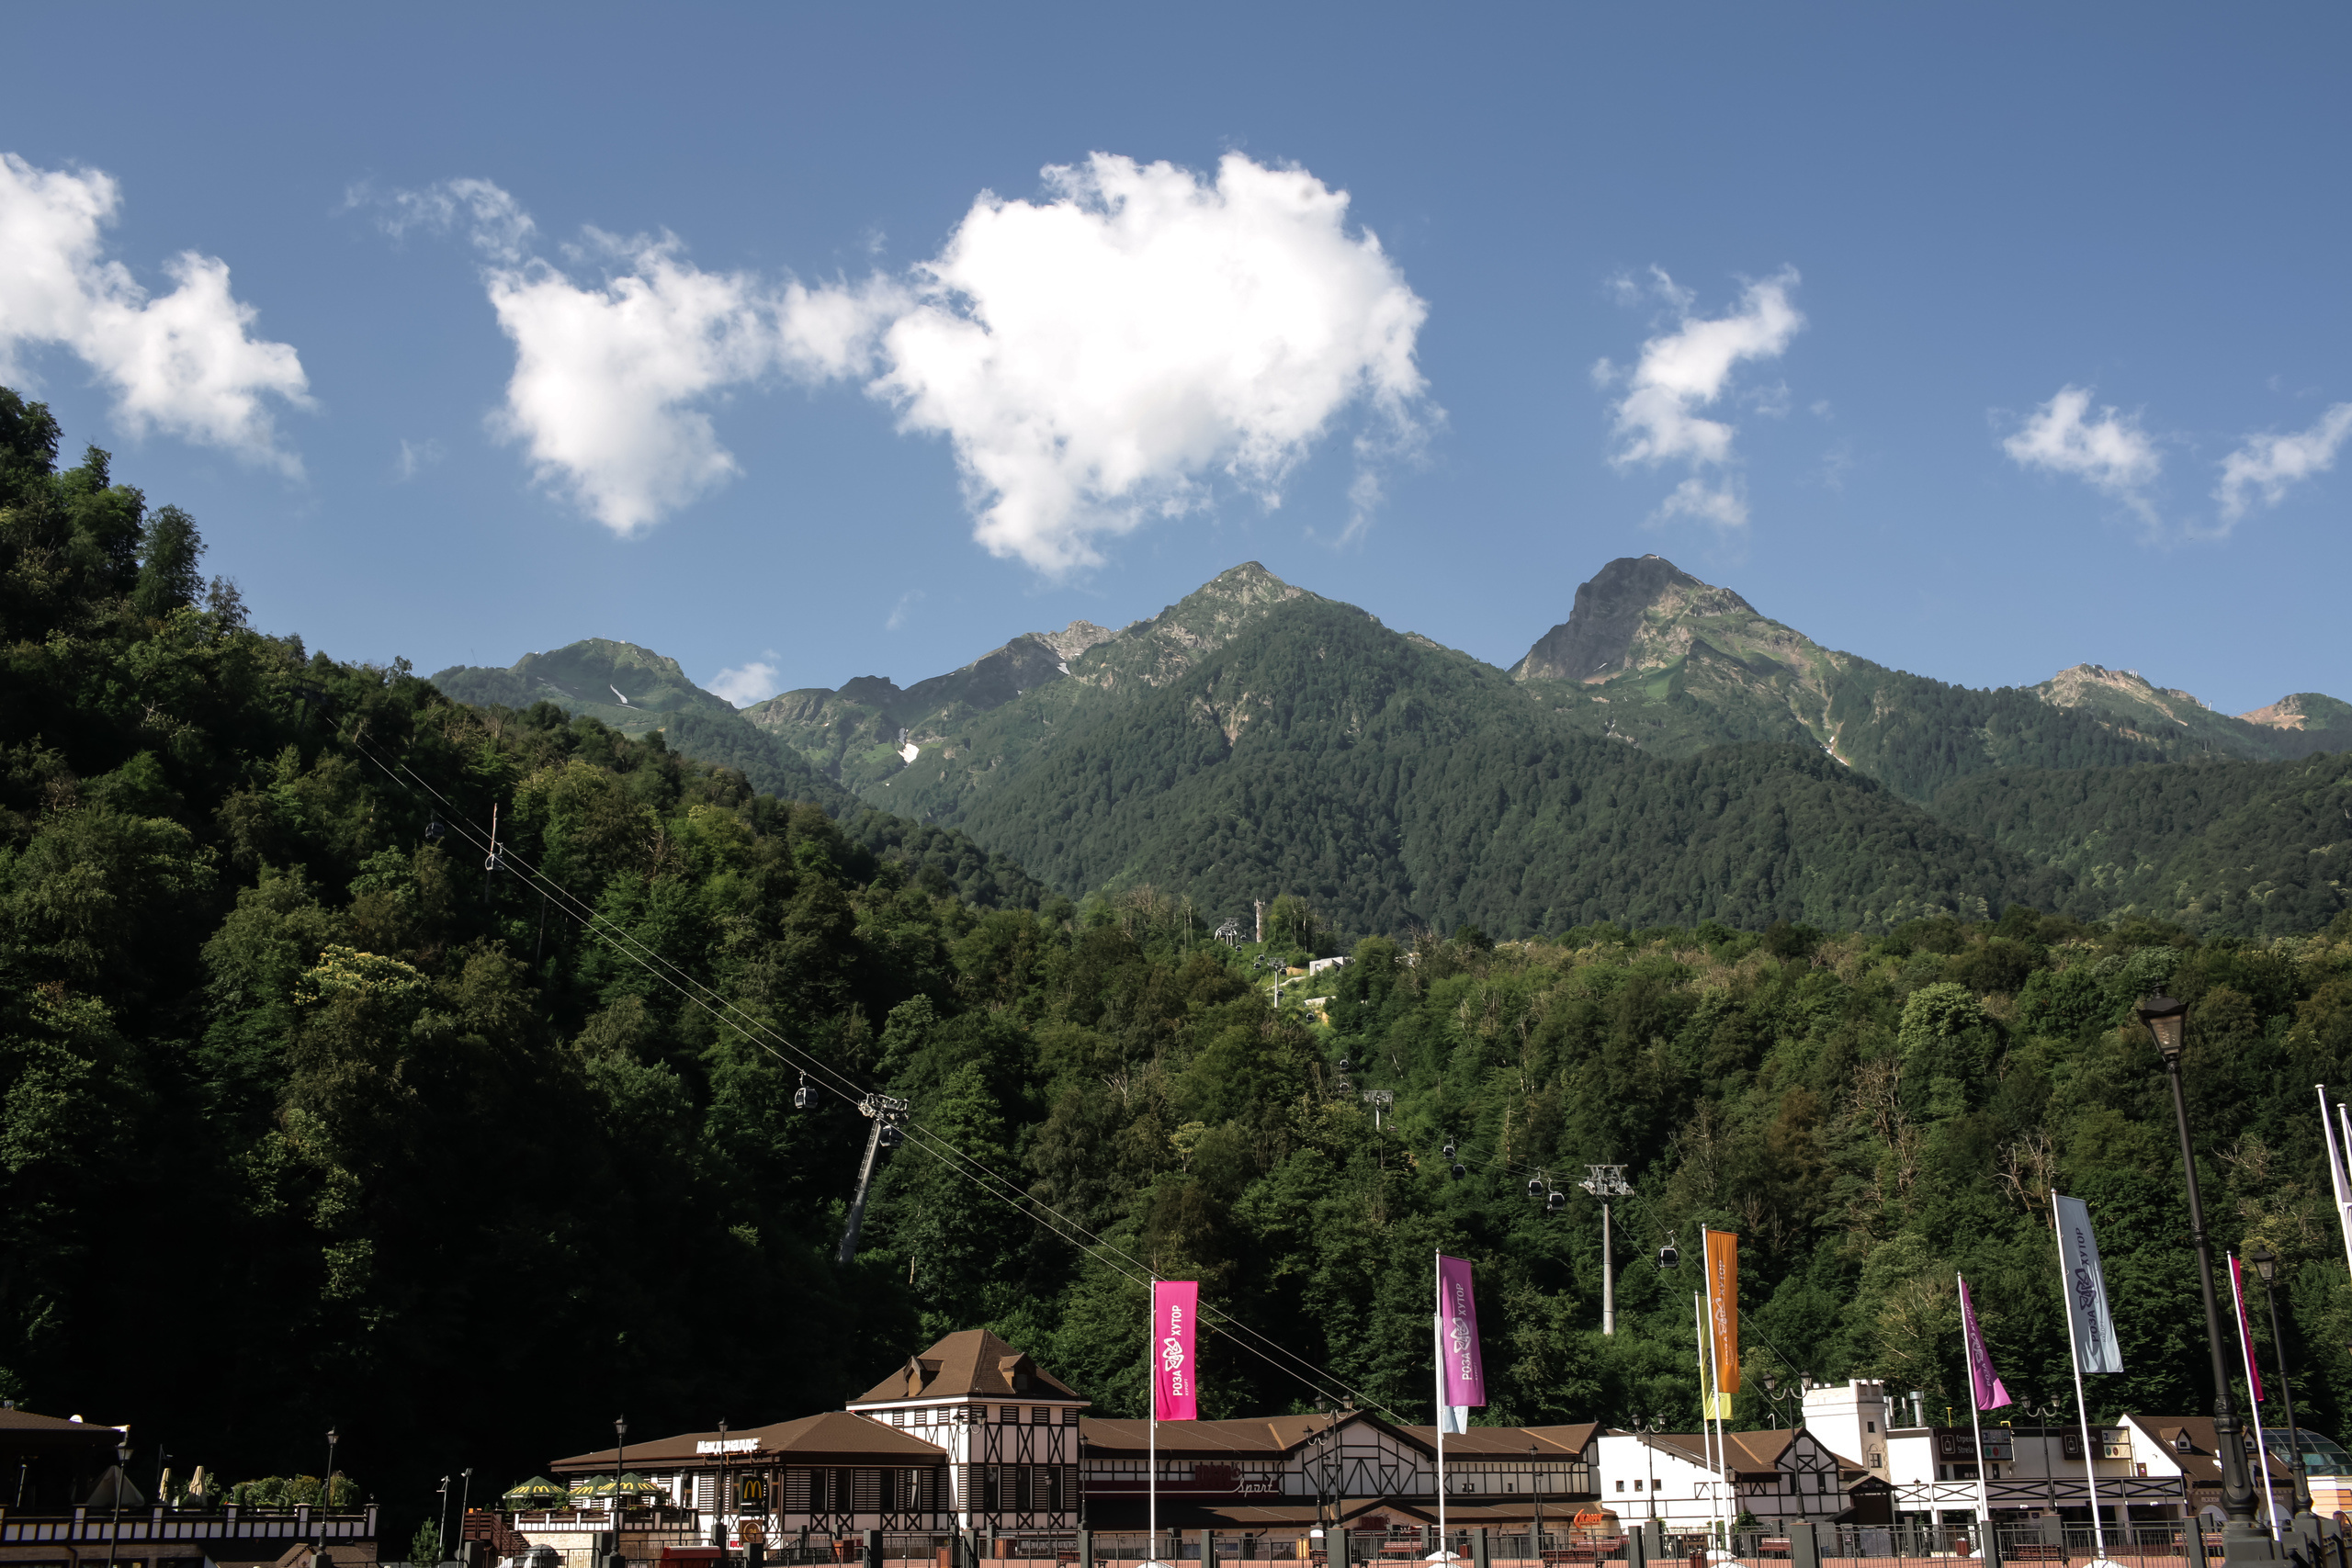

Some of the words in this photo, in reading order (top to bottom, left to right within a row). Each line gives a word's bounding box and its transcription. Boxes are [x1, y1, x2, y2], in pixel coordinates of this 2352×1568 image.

[2075, 1227, 2089, 1266] ХУТОР
[1455, 1282, 1467, 1316] ХУТОР
[1171, 1304, 1182, 1336] ХУТОР
[2087, 1310, 2099, 1342] РОЗА
[1461, 1352, 1473, 1381] РОЗА
[1172, 1370, 1183, 1396] РОЗА
[1956, 1434, 1976, 1444] Стрела
